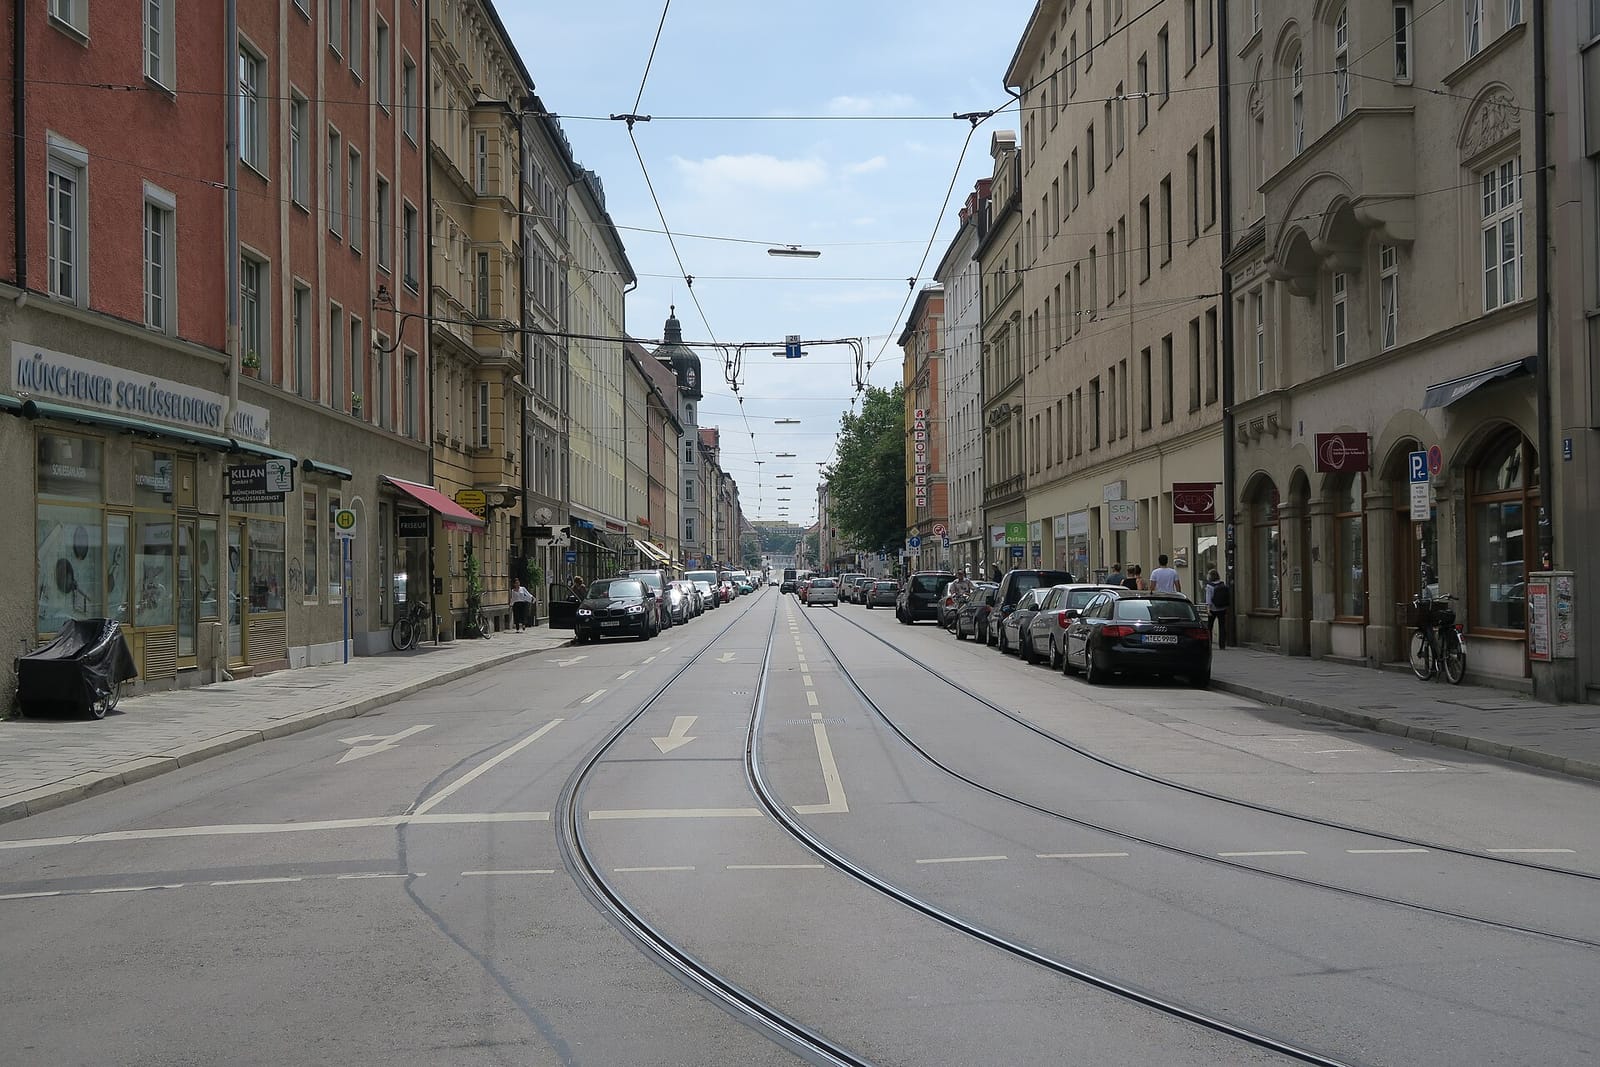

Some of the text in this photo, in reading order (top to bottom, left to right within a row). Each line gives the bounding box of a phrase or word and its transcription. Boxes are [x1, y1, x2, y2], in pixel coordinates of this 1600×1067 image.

[17, 353, 222, 427] MÜNCHENER SCHLÜSSELDIENST
[916, 422, 925, 506] APOTHEKE
[1412, 456, 1422, 479] P
[231, 468, 265, 479] KILIAN
[232, 488, 265, 496] MÜNCHENER
[232, 494, 279, 503] SCHLÜSSELDIENST
[1111, 504, 1133, 513] SEN
[341, 514, 350, 525] H
